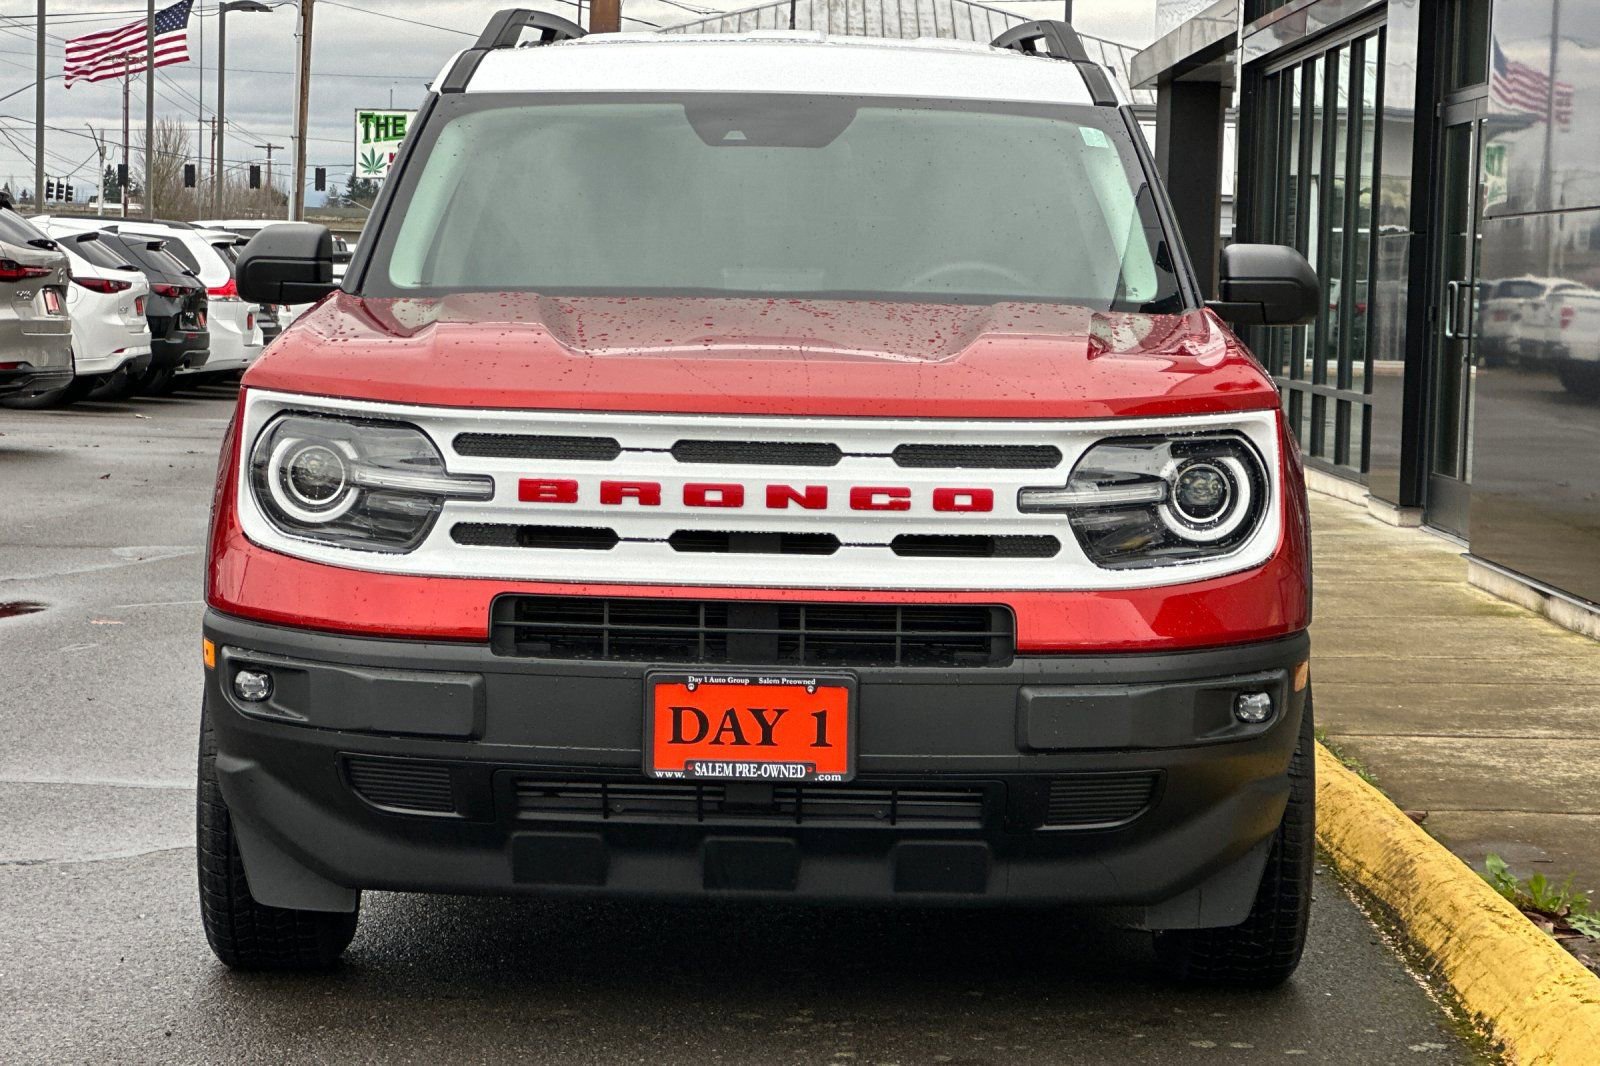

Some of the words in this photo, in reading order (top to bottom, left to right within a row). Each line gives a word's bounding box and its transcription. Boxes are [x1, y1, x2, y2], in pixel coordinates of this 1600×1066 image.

[359, 112, 407, 144] THE
[518, 478, 994, 512] BRONCO
[688, 676, 703, 685] Day
[727, 677, 750, 685] Group
[667, 707, 790, 746] DAY
[810, 710, 833, 747] 1
[694, 762, 733, 777] SALEM
[735, 763, 806, 778] PRE-OWNED
